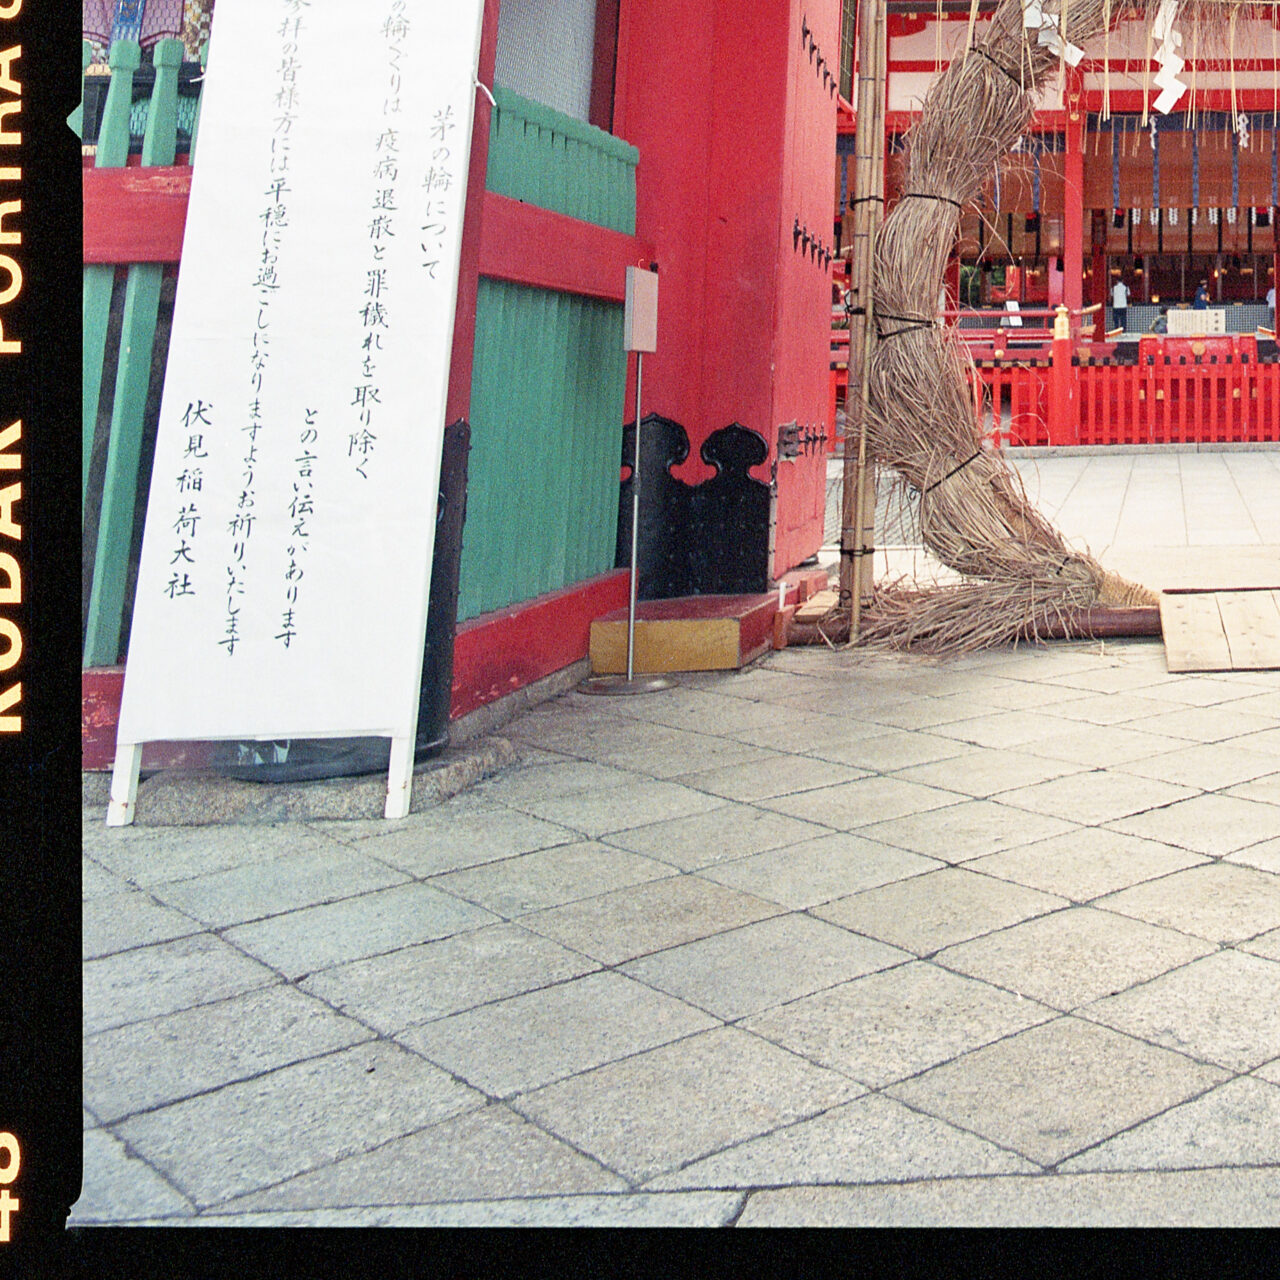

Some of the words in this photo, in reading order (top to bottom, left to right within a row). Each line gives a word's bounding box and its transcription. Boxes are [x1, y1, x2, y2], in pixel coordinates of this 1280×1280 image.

[0, 44, 22, 353] PORTRA
[421, 104, 456, 280] 茅の輪について
[0, 419, 22, 732] KODAK
[163, 399, 214, 600] 伏見稲荷大社
[274, 406, 319, 650] との言い伝えがあります
